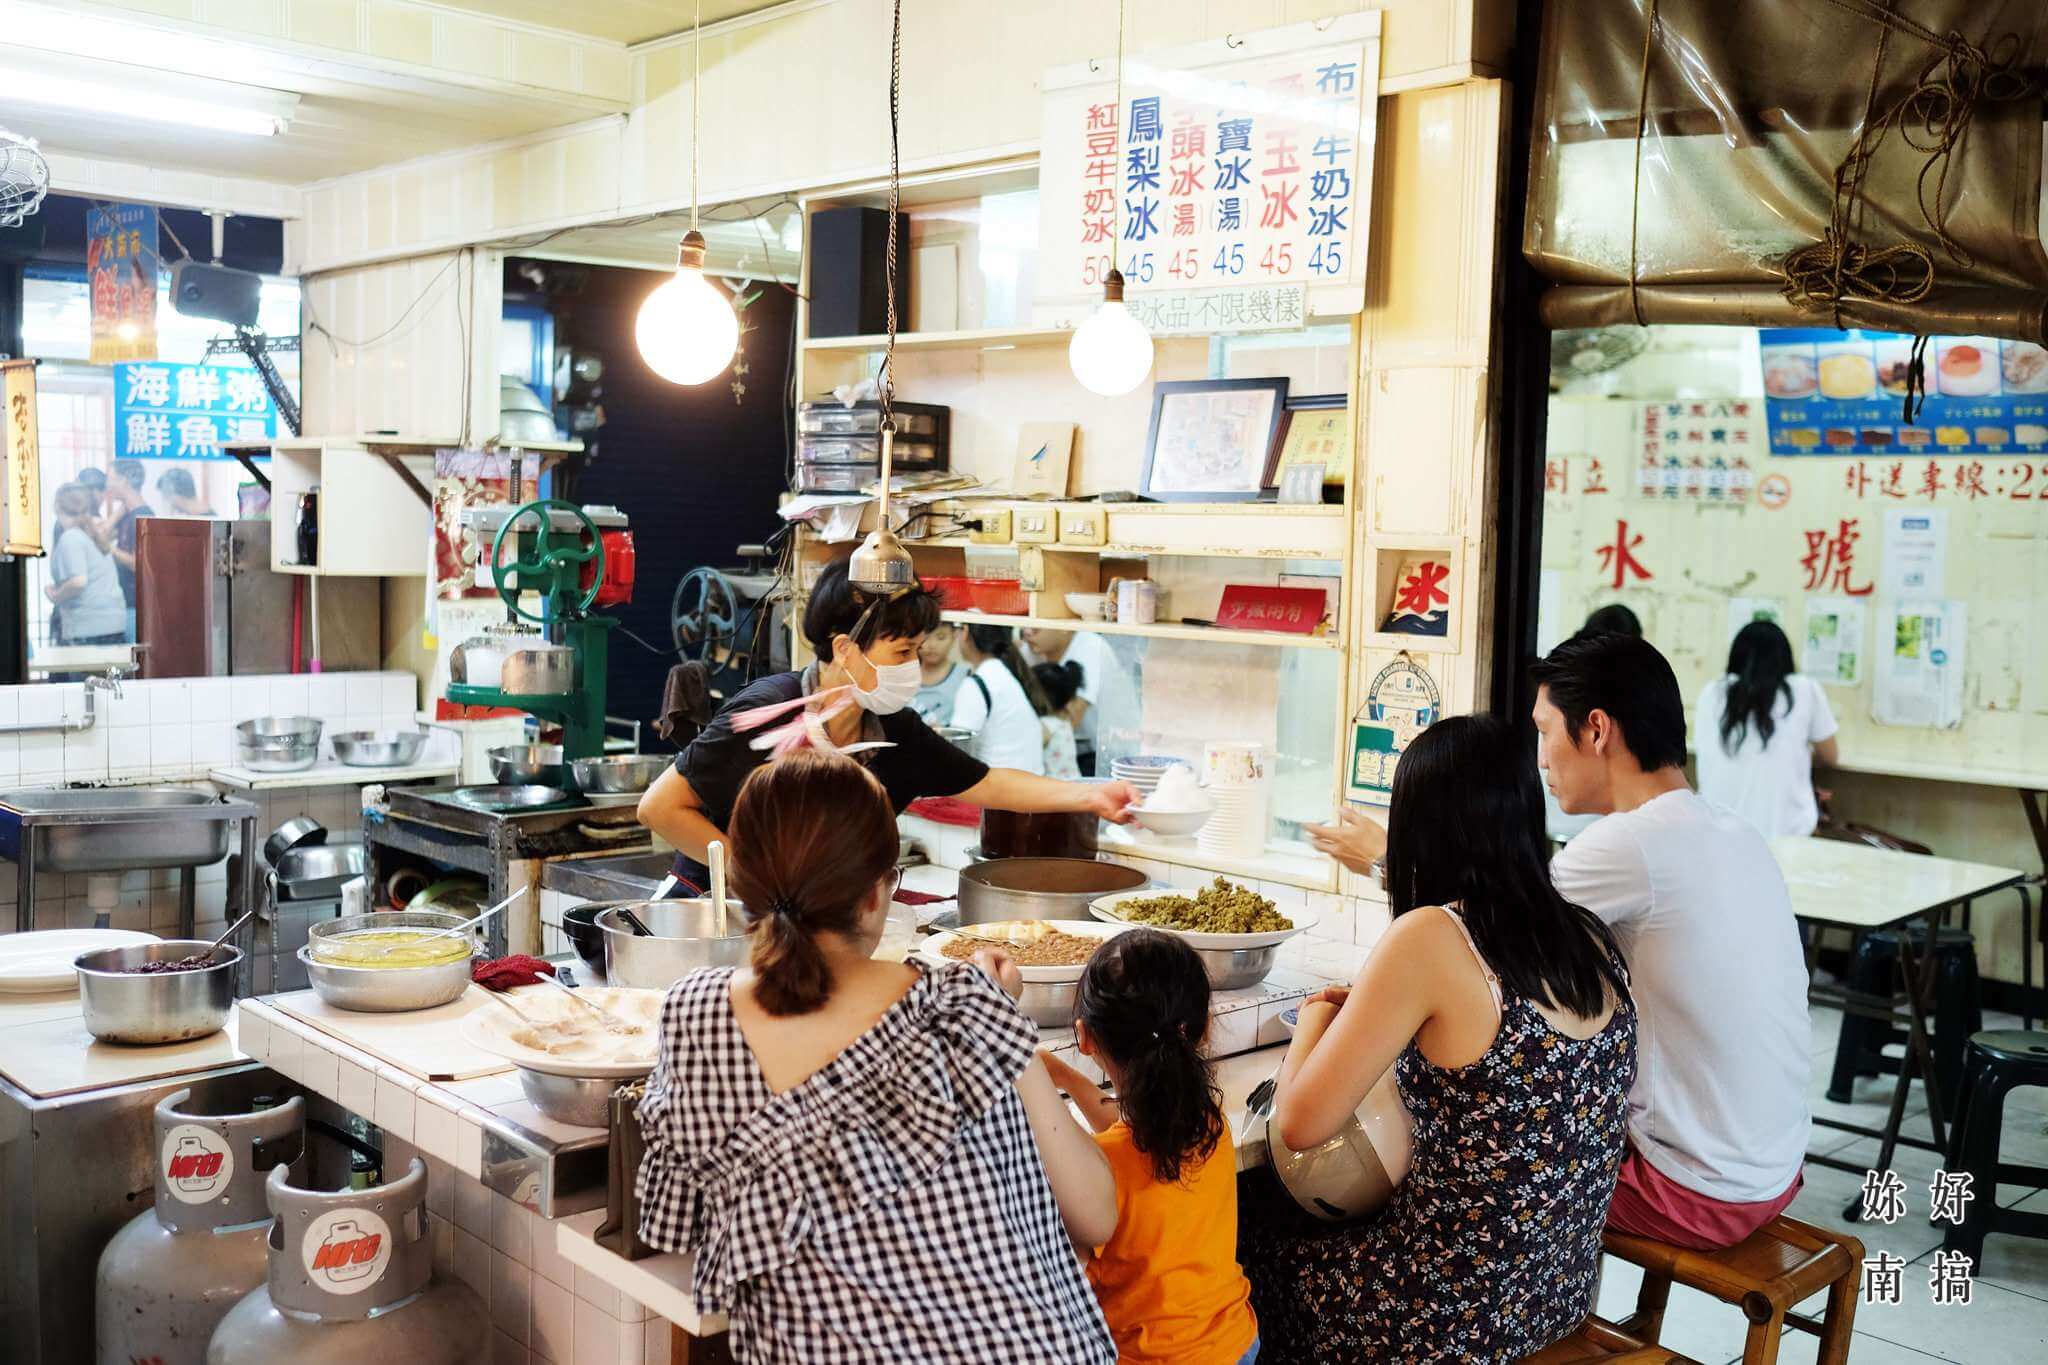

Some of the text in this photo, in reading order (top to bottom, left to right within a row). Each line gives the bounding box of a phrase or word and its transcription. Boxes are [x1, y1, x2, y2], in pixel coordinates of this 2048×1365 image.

[1082, 103, 1118, 243] 紅豆牛奶冰
[1124, 96, 1163, 242] 鳳梨冰
[1164, 109, 1209, 239] 頭冰(湯)
[1209, 80, 1254, 233] 寶冰(湯)
[1259, 73, 1305, 230] 玉冰
[1307, 62, 1357, 237] 布牛奶冰
[1082, 255, 1111, 286] 50
[1125, 253, 1155, 284] 45
[1169, 248, 1199, 280] 45
[1213, 243, 1245, 276] 45
[1260, 242, 1293, 276] 45
[1308, 241, 1342, 276] 45
[126, 365, 267, 412] 海鮮粥
[1595, 518, 1875, 596] 水 號
